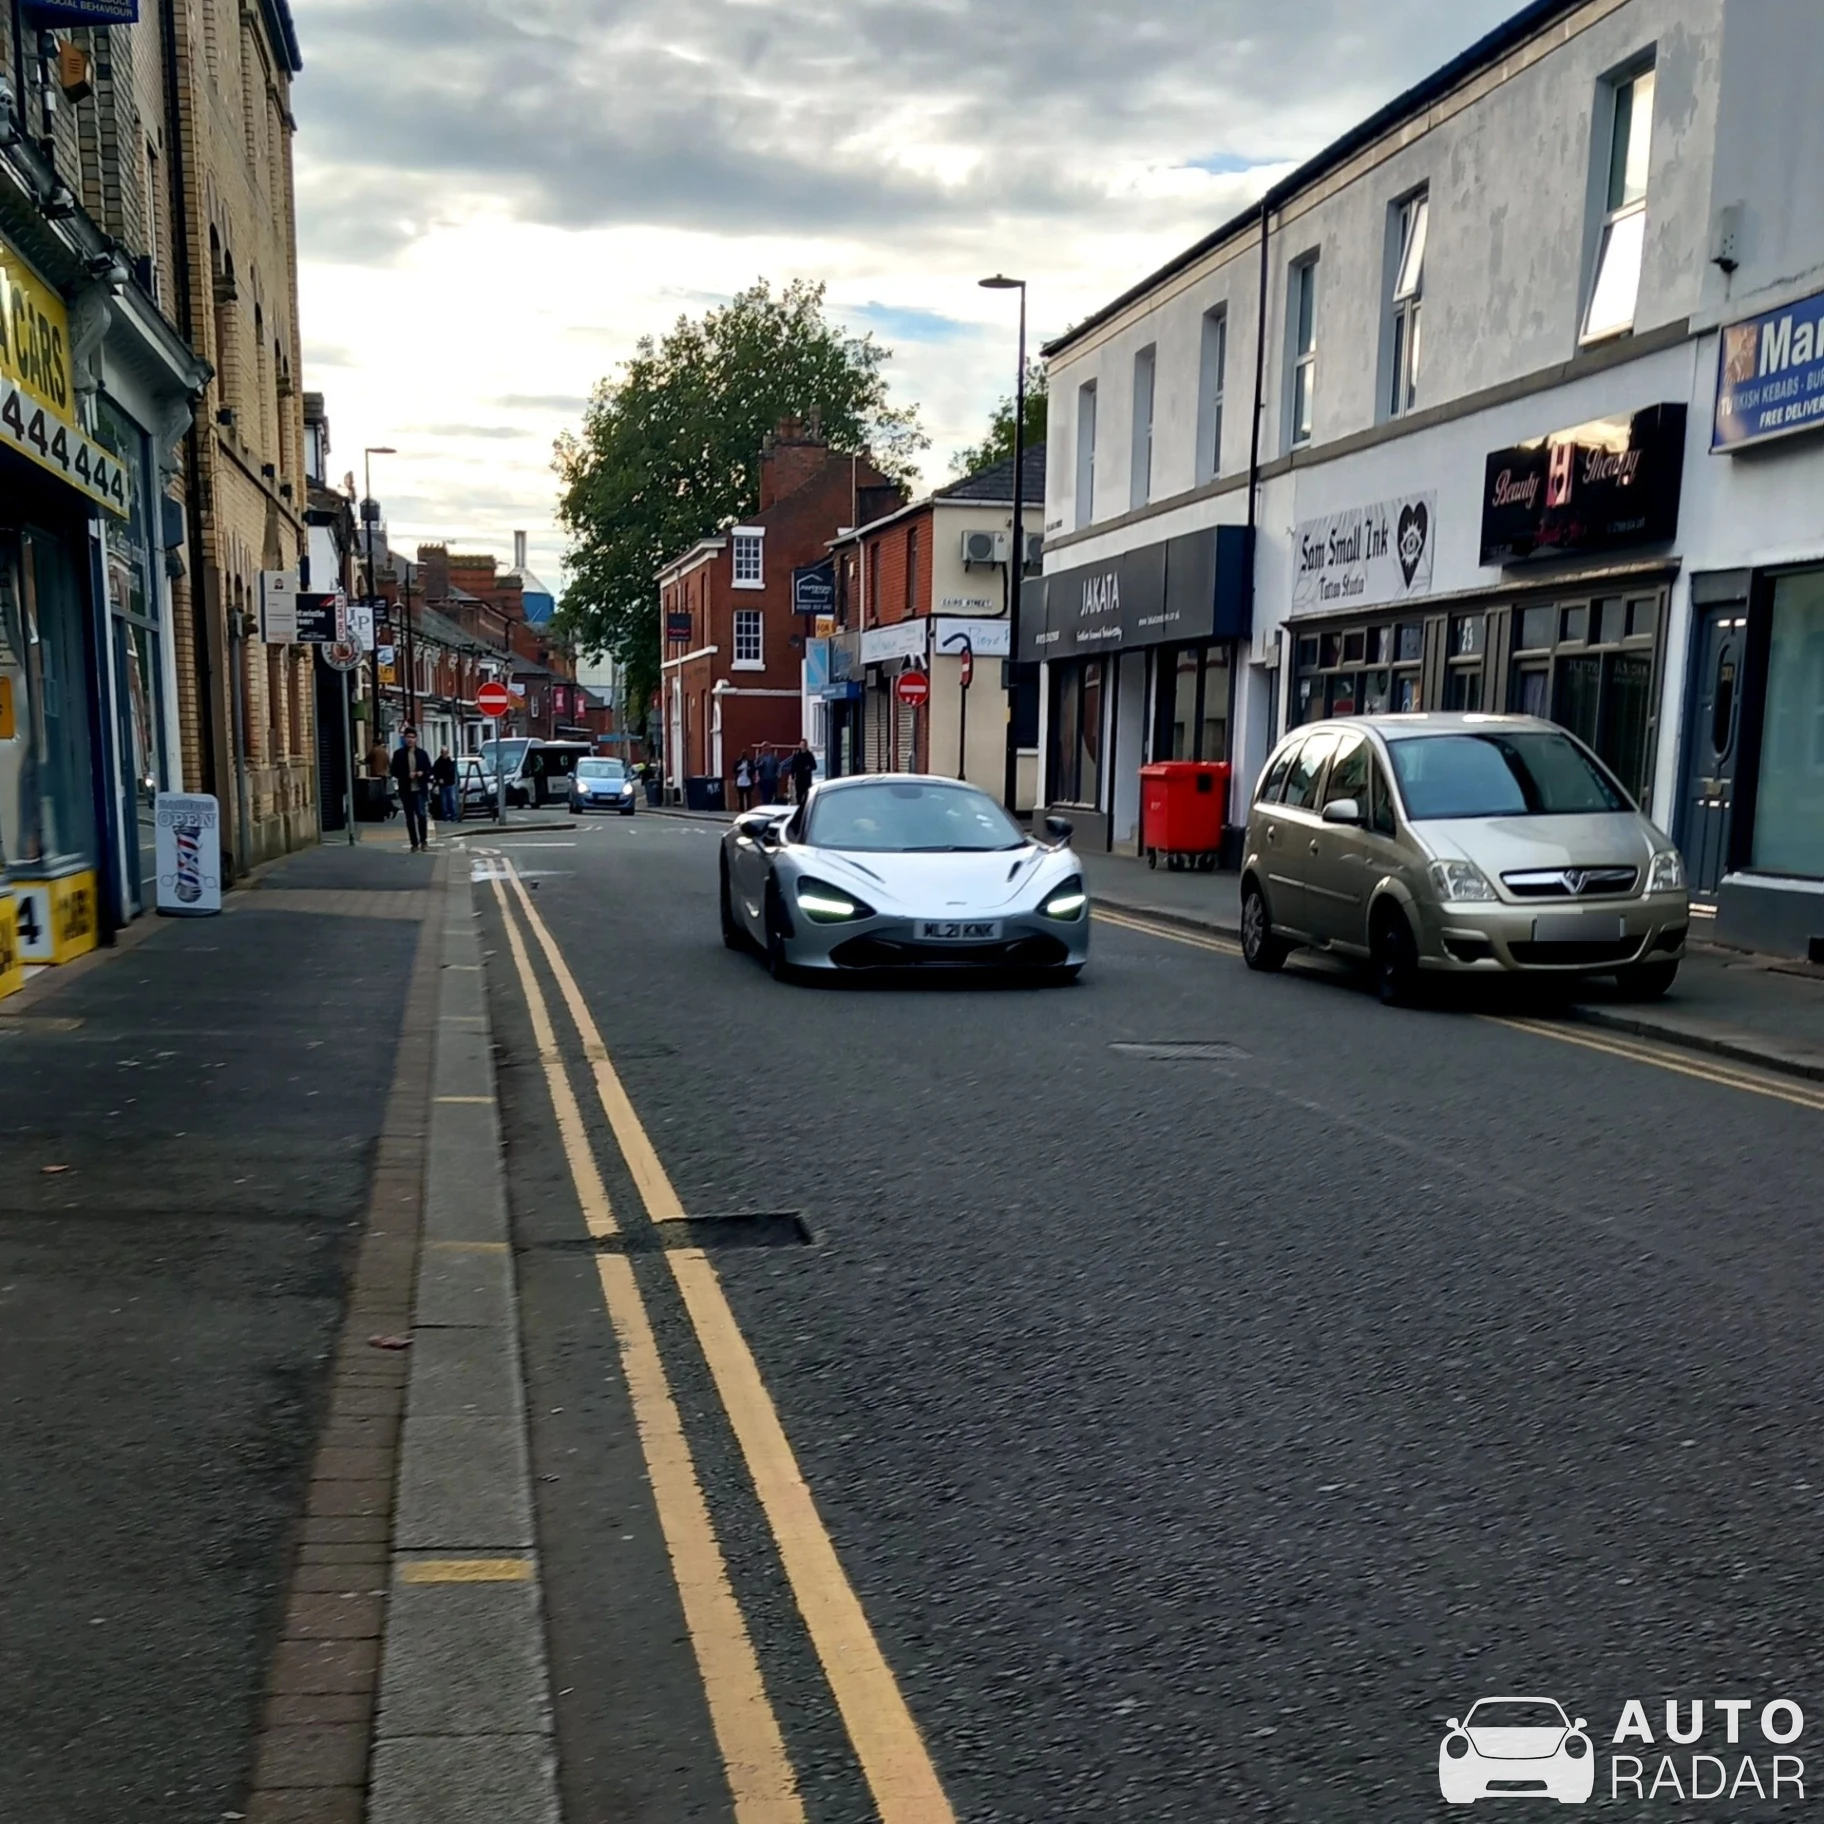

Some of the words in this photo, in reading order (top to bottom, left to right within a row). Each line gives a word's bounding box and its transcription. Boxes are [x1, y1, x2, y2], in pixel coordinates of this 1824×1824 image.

[80, 1, 133, 17] BEHAVIOUR
[13, 286, 66, 409] CARS
[1762, 376, 1799, 403] KEBABS
[1759, 407, 1784, 428] FREE
[1492, 468, 1542, 509] Beauty
[1583, 447, 1643, 486] Therapy
[1301, 533, 1325, 572] Sam
[1328, 528, 1361, 567] Small
[1365, 517, 1388, 560] Ink
[1080, 571, 1120, 617] JAKATA
[337, 621, 345, 640] FOR
[157, 810, 217, 829] OPEN
